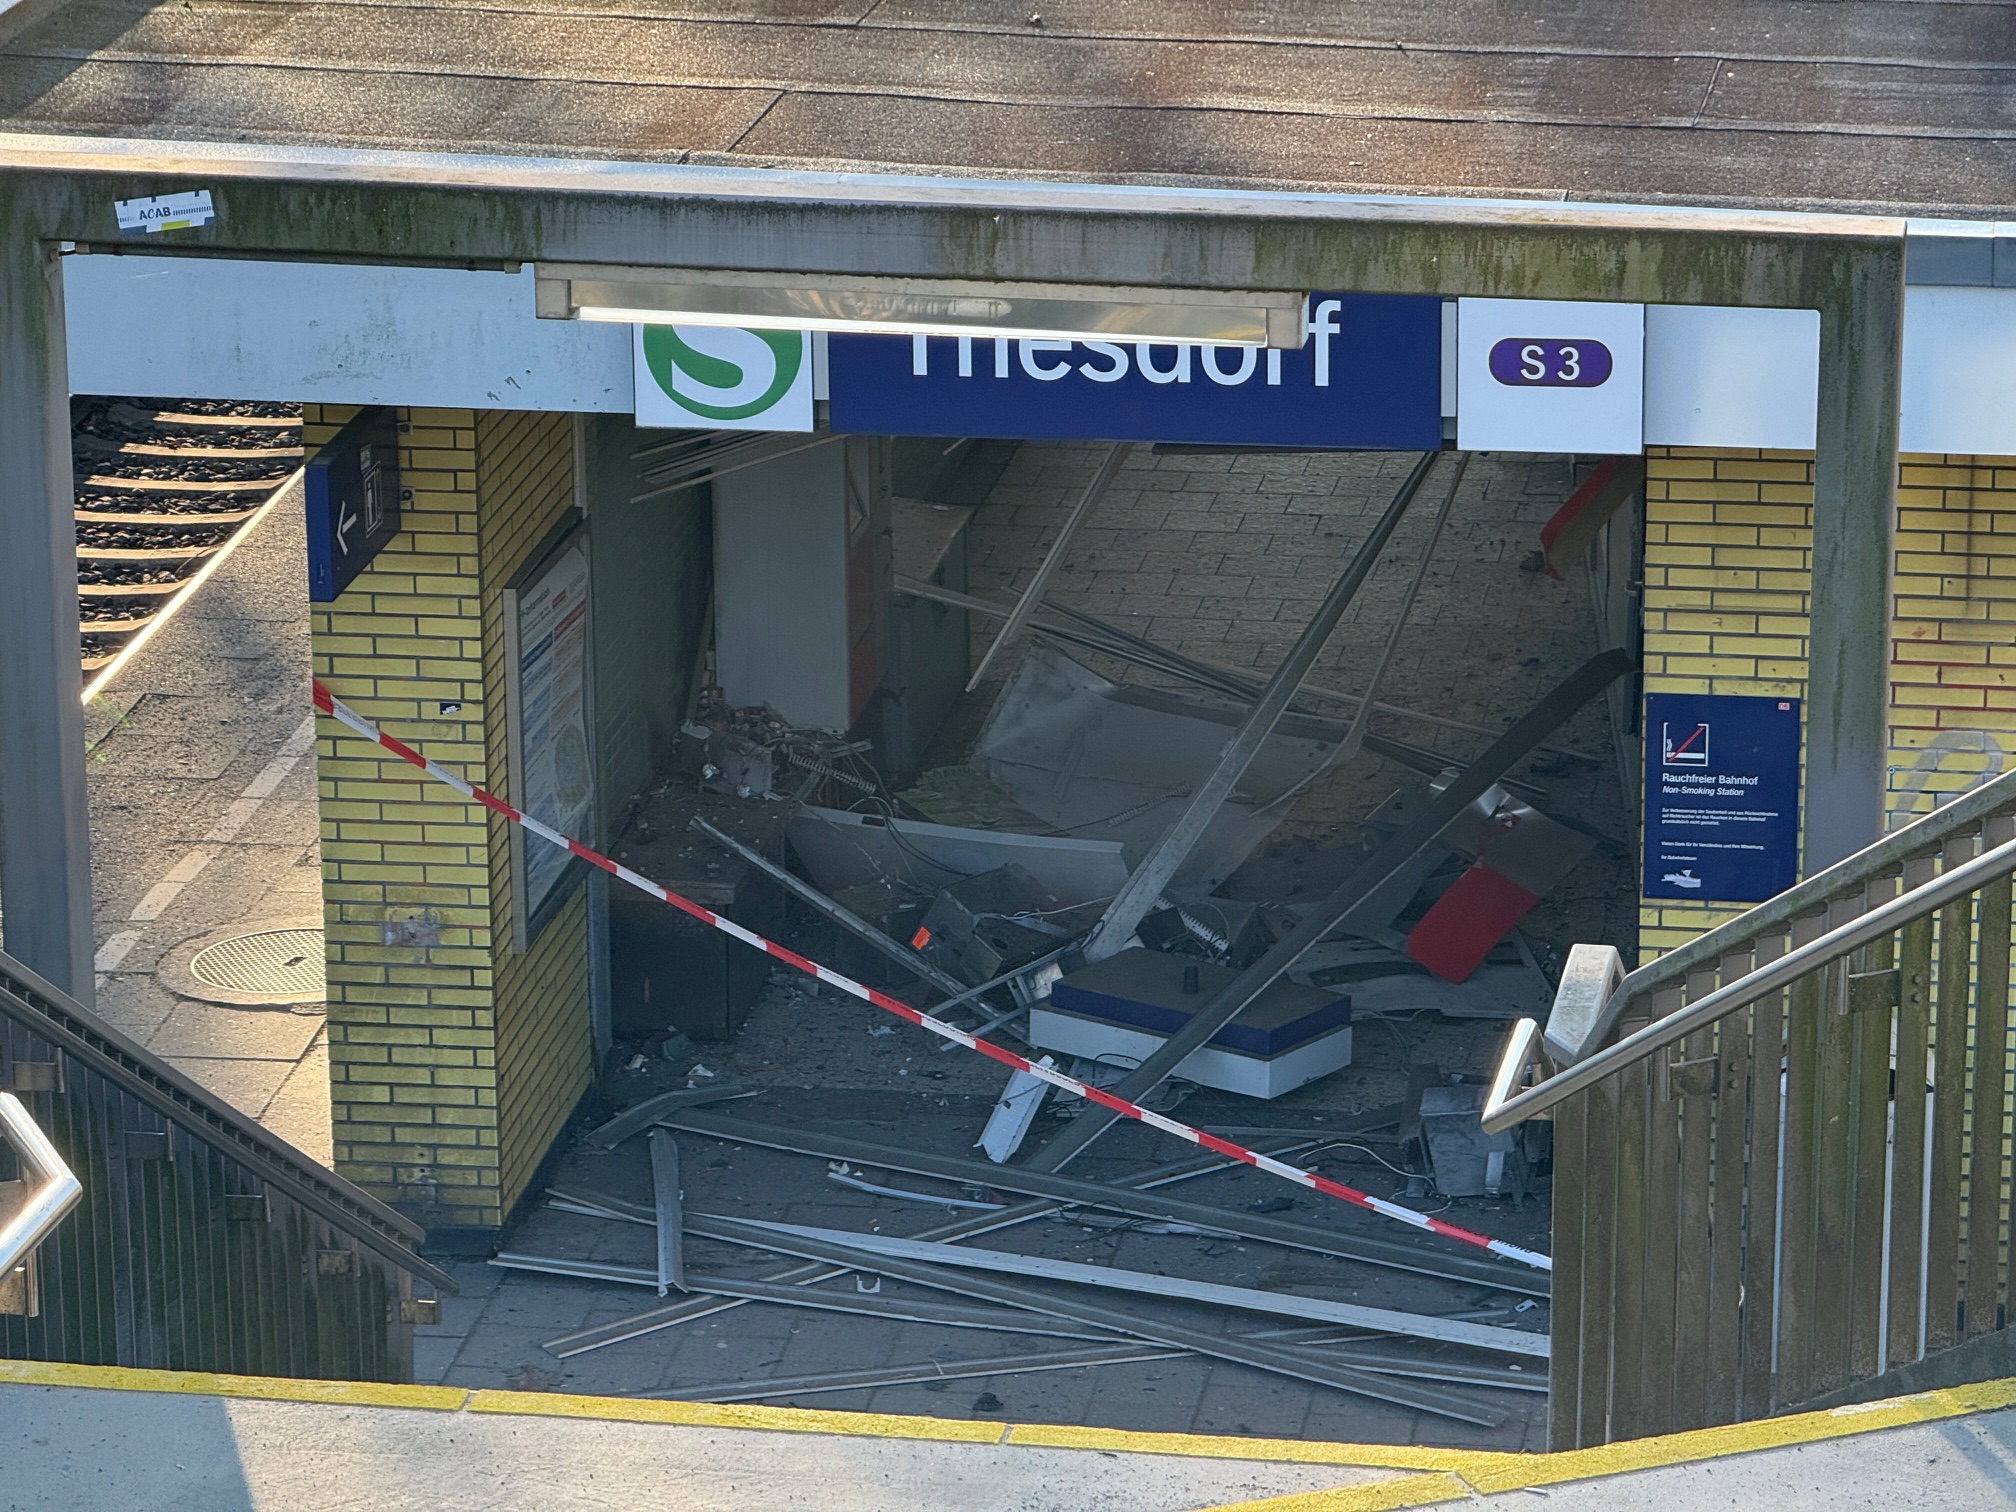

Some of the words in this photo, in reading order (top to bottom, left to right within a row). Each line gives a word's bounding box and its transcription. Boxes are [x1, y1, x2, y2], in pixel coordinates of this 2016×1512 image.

[139, 206, 171, 220] ACAB
[1520, 345, 1546, 380] S
[1557, 346, 1580, 381] 3
[1662, 773, 1716, 784] Rauchfreier
[1718, 775, 1759, 785] Bahnhof
[1662, 786, 1715, 796] Non-Smoking
[1717, 787, 1744, 796] Station
